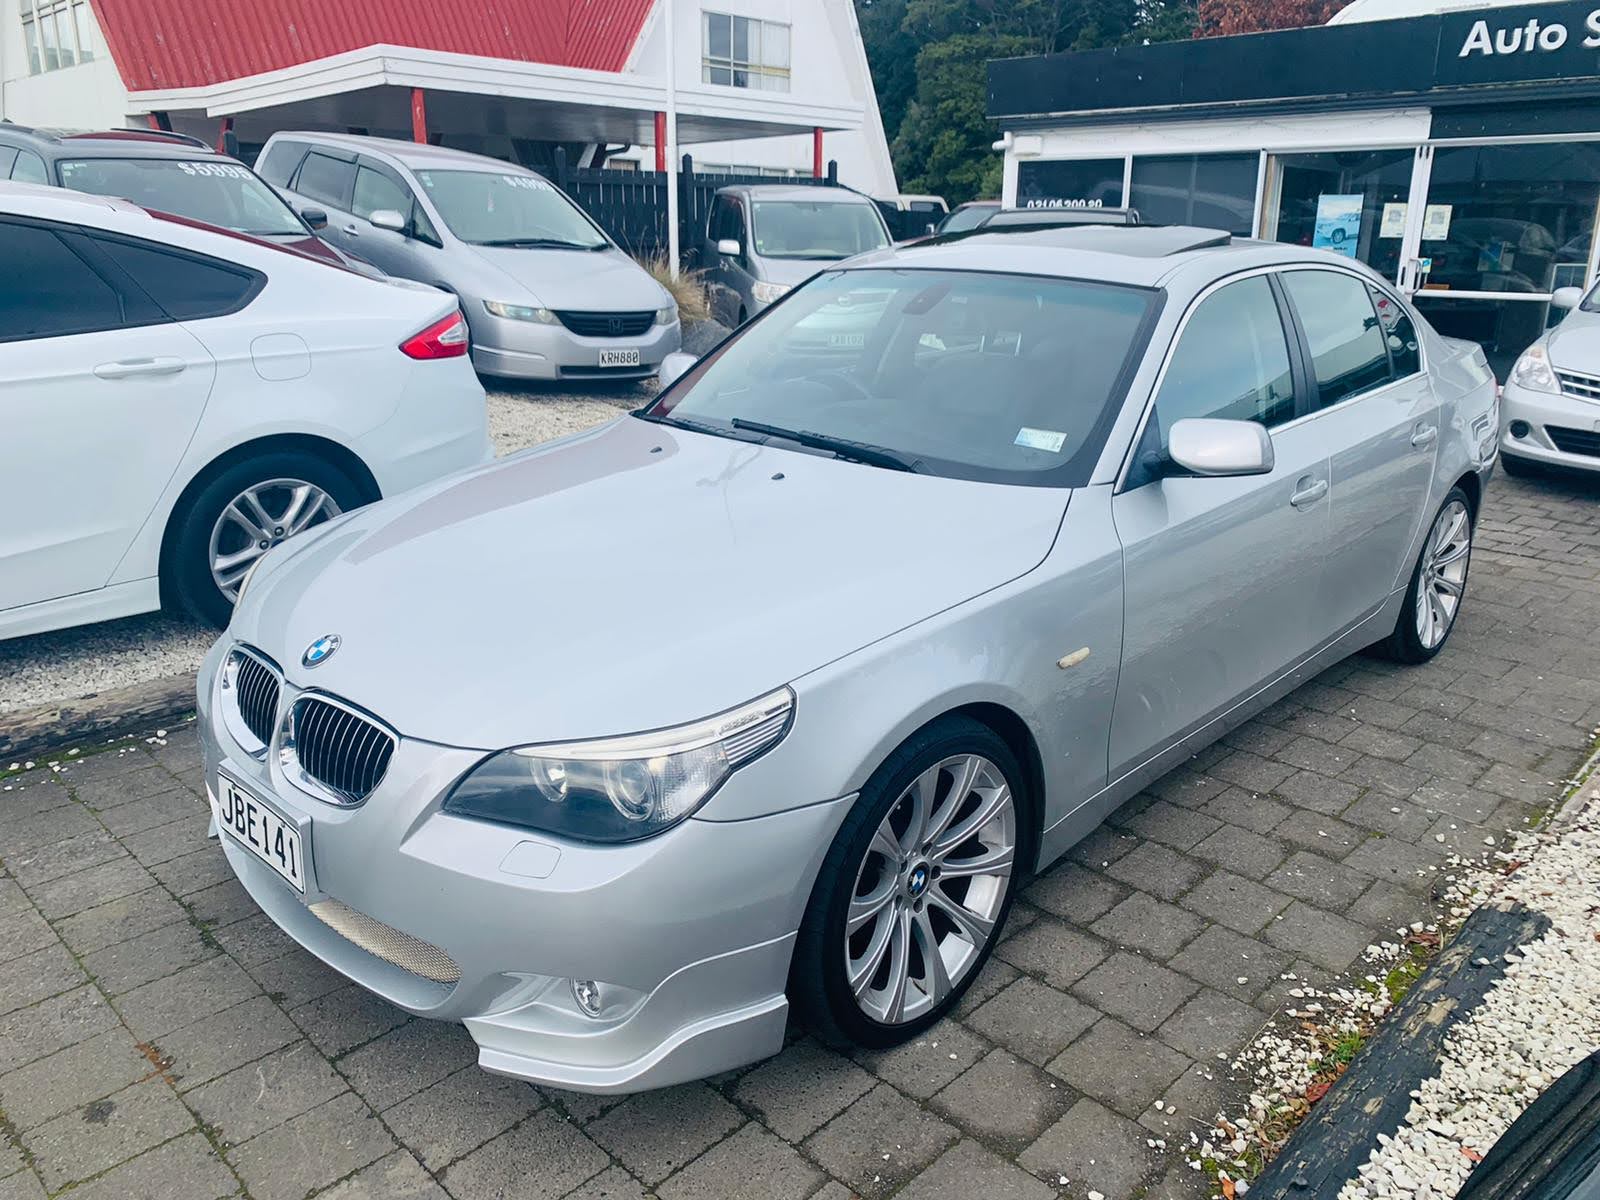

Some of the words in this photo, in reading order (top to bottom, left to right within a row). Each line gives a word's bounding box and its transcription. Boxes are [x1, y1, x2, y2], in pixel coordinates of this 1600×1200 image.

[1458, 19, 1568, 57] Auto
[177, 161, 254, 180] $5995
[222, 788, 297, 878] JBE141
